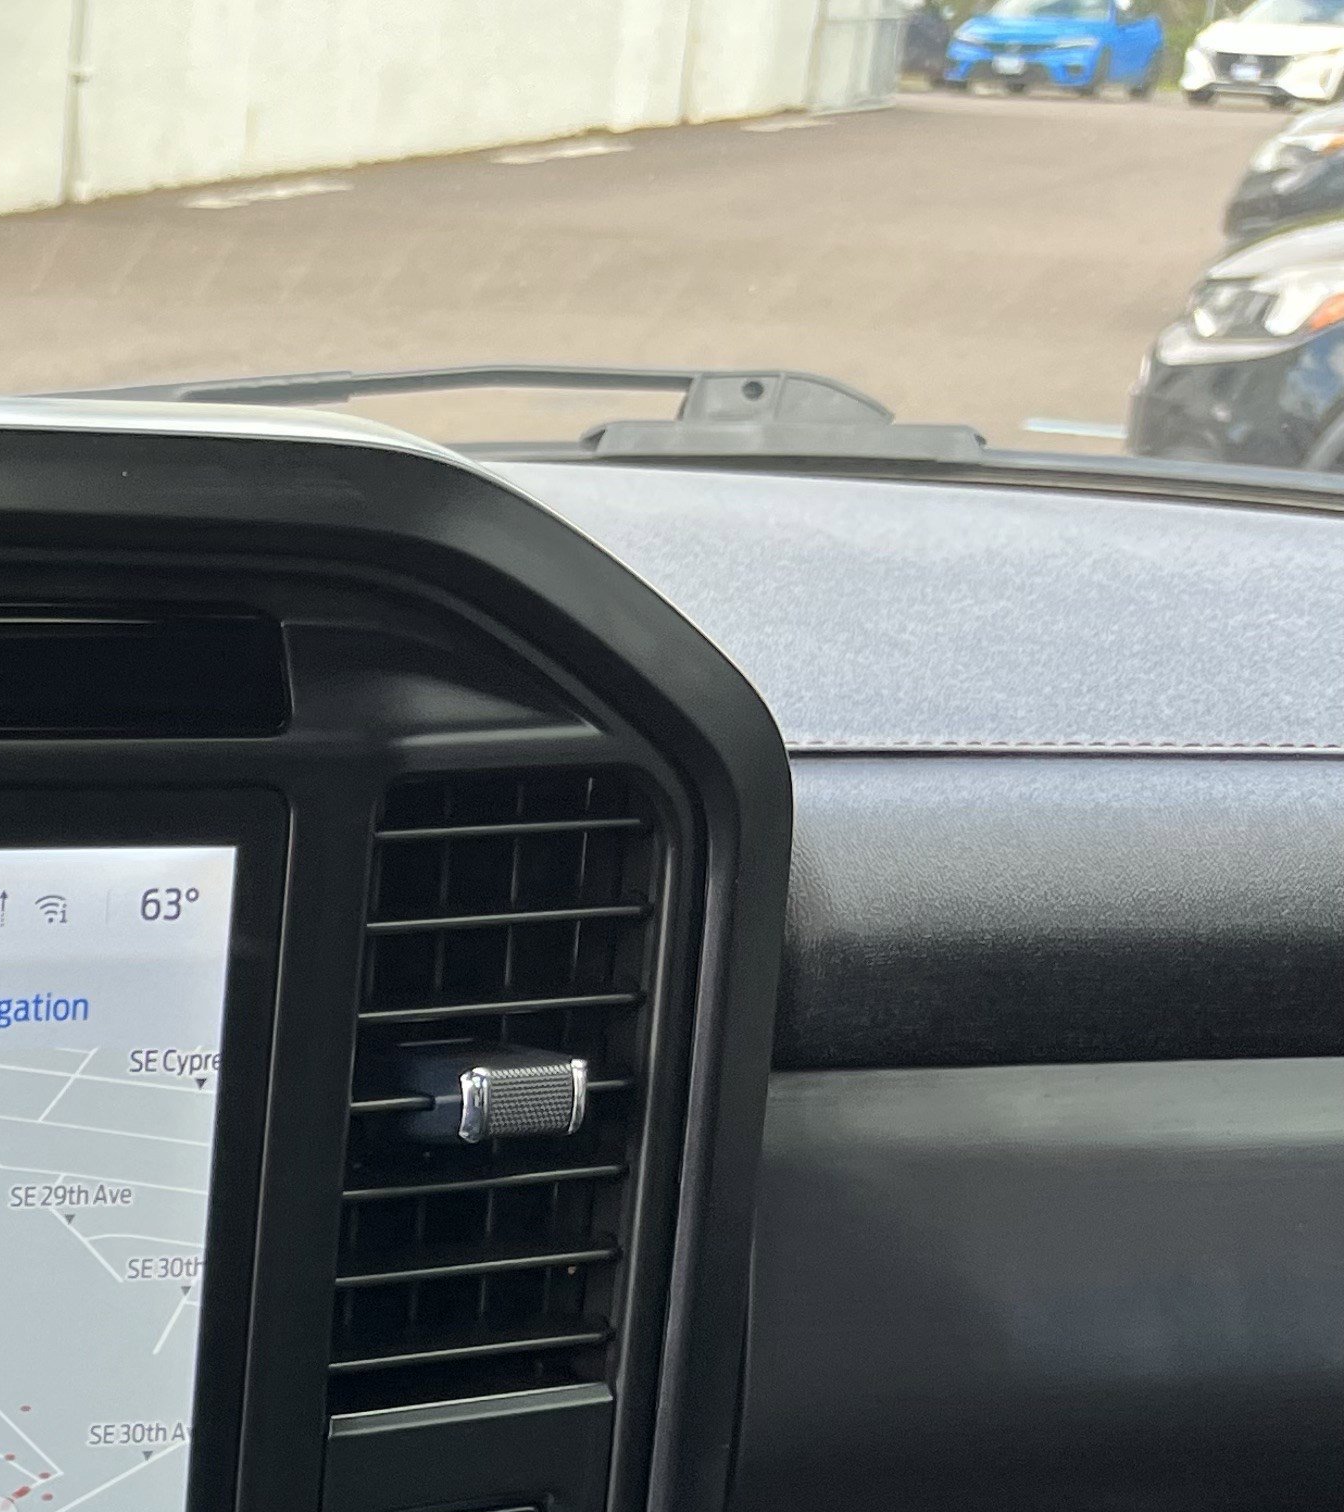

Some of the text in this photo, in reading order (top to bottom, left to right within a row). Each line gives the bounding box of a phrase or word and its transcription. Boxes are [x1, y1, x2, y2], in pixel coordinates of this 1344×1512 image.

[140, 887, 200, 922] 63°
[129, 1049, 159, 1073] SE
[10, 1184, 132, 1207] SE 29th Ave
[127, 1258, 154, 1279] SE
[88, 1424, 116, 1445] SE
[118, 1422, 167, 1444] 30th
